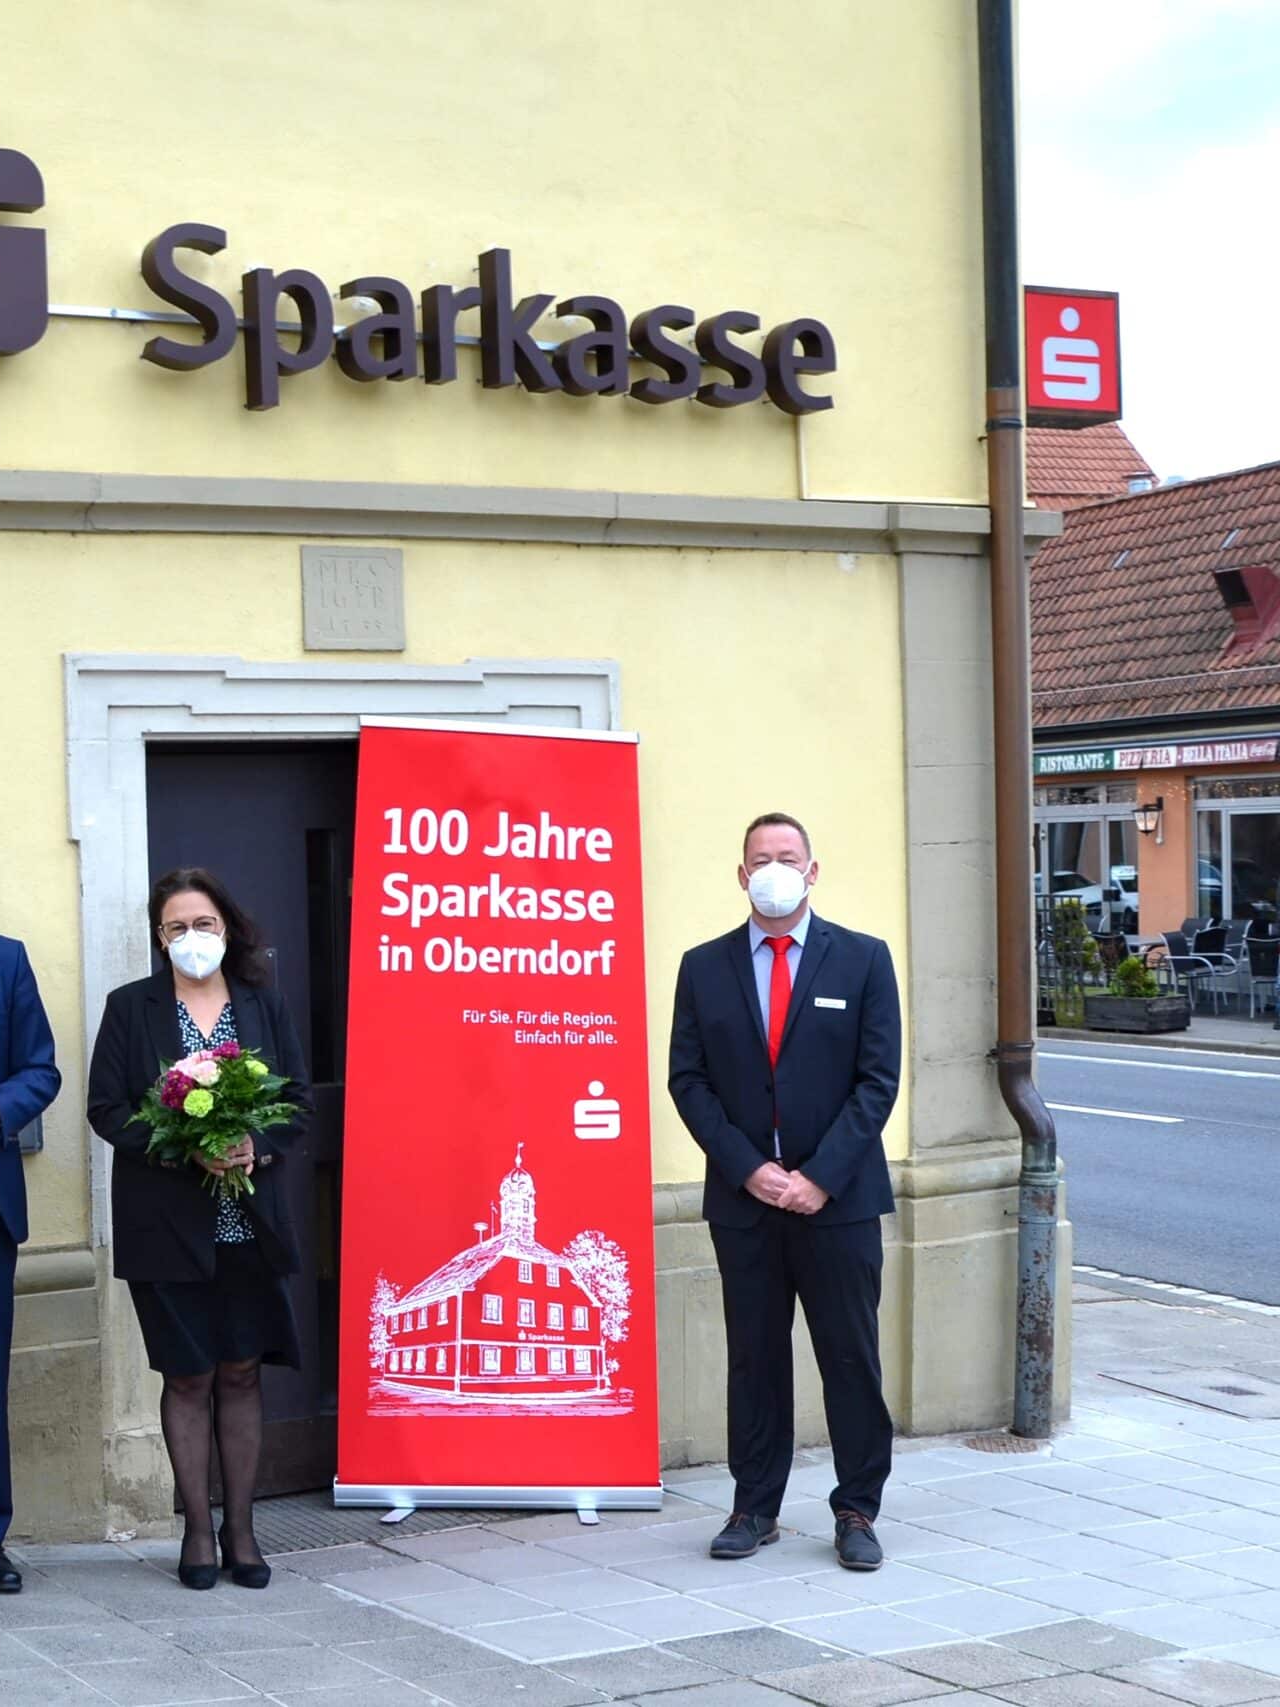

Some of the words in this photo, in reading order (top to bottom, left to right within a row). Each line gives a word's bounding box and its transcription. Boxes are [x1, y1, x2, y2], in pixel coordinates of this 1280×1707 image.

[140, 223, 838, 415] Sparkasse
[1039, 753, 1105, 773] RISTORANTE
[1119, 749, 1172, 768] PIZZERIA
[1183, 744, 1213, 763] BELLA
[1214, 742, 1249, 761] ITALIA
[383, 807, 468, 856] 100
[483, 811, 613, 863] Jahre
[380, 872, 615, 928] Sparkasse
[378, 934, 413, 972] in
[424, 936, 616, 976] Oberndorf
[462, 1010, 486, 1024] Für
[489, 1010, 513, 1024] Sie.
[516, 1010, 538, 1025] Für
[540, 1011, 560, 1025] die
[563, 1012, 617, 1029] Region.
[514, 1029, 561, 1045] Einfach
[564, 1030, 585, 1045] für
[587, 1030, 618, 1045] alle.
